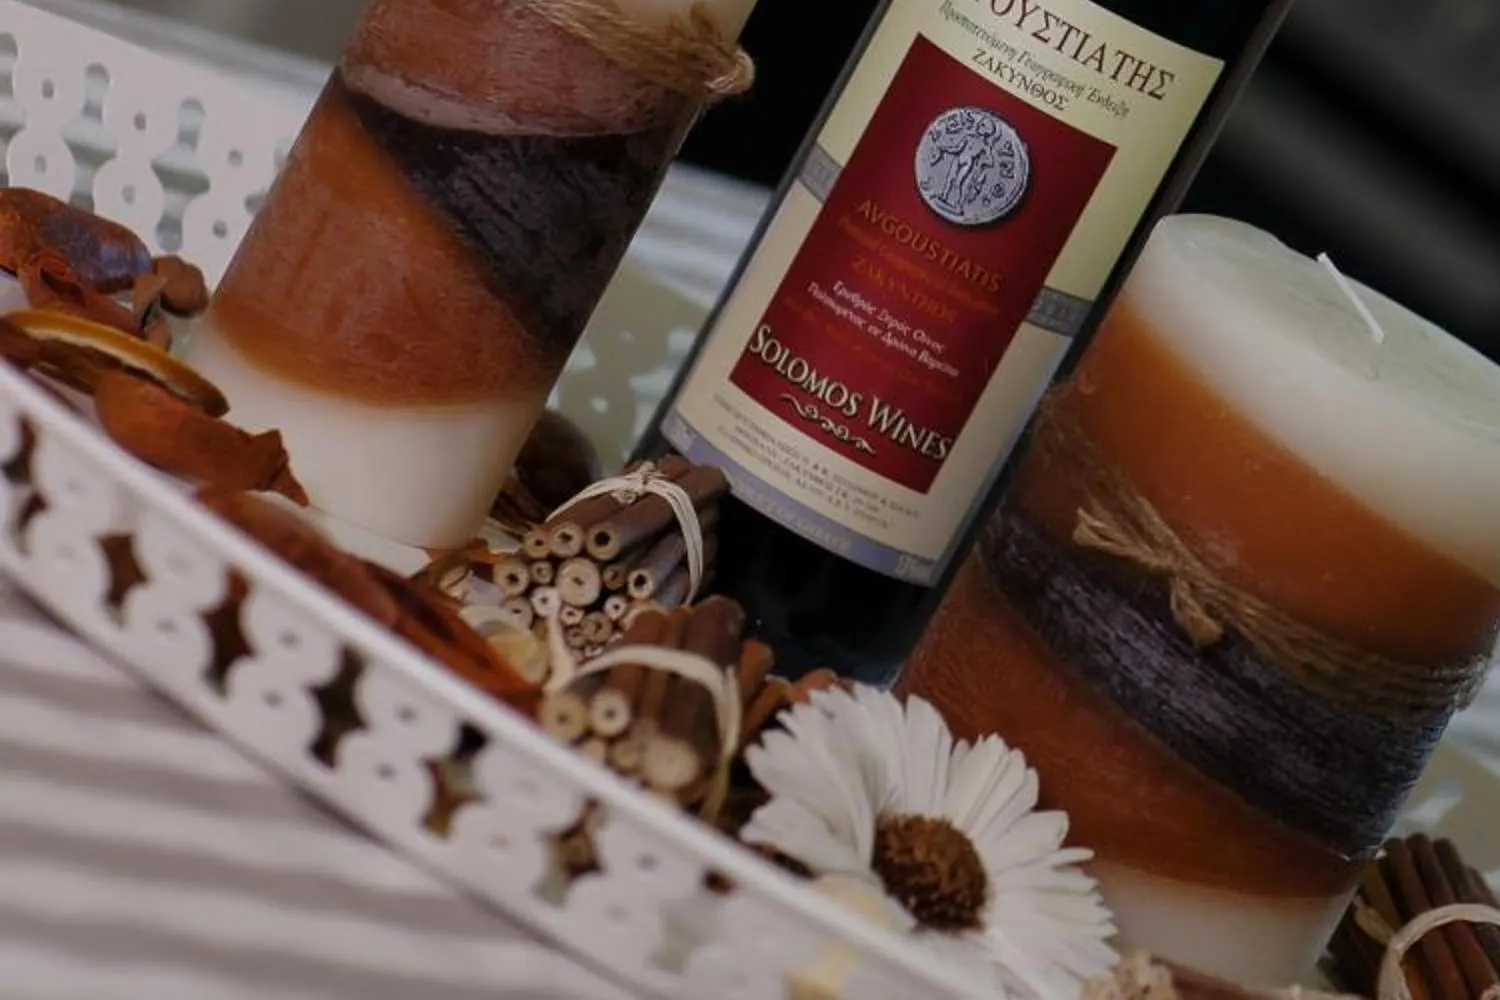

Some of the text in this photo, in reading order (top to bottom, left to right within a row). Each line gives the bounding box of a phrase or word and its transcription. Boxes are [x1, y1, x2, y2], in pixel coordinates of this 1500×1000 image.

[970, 46, 1070, 111] ΖΑΚΥΝΘΟΣ
[745, 321, 865, 419] SOLOMOS
[862, 395, 953, 462] WINES
